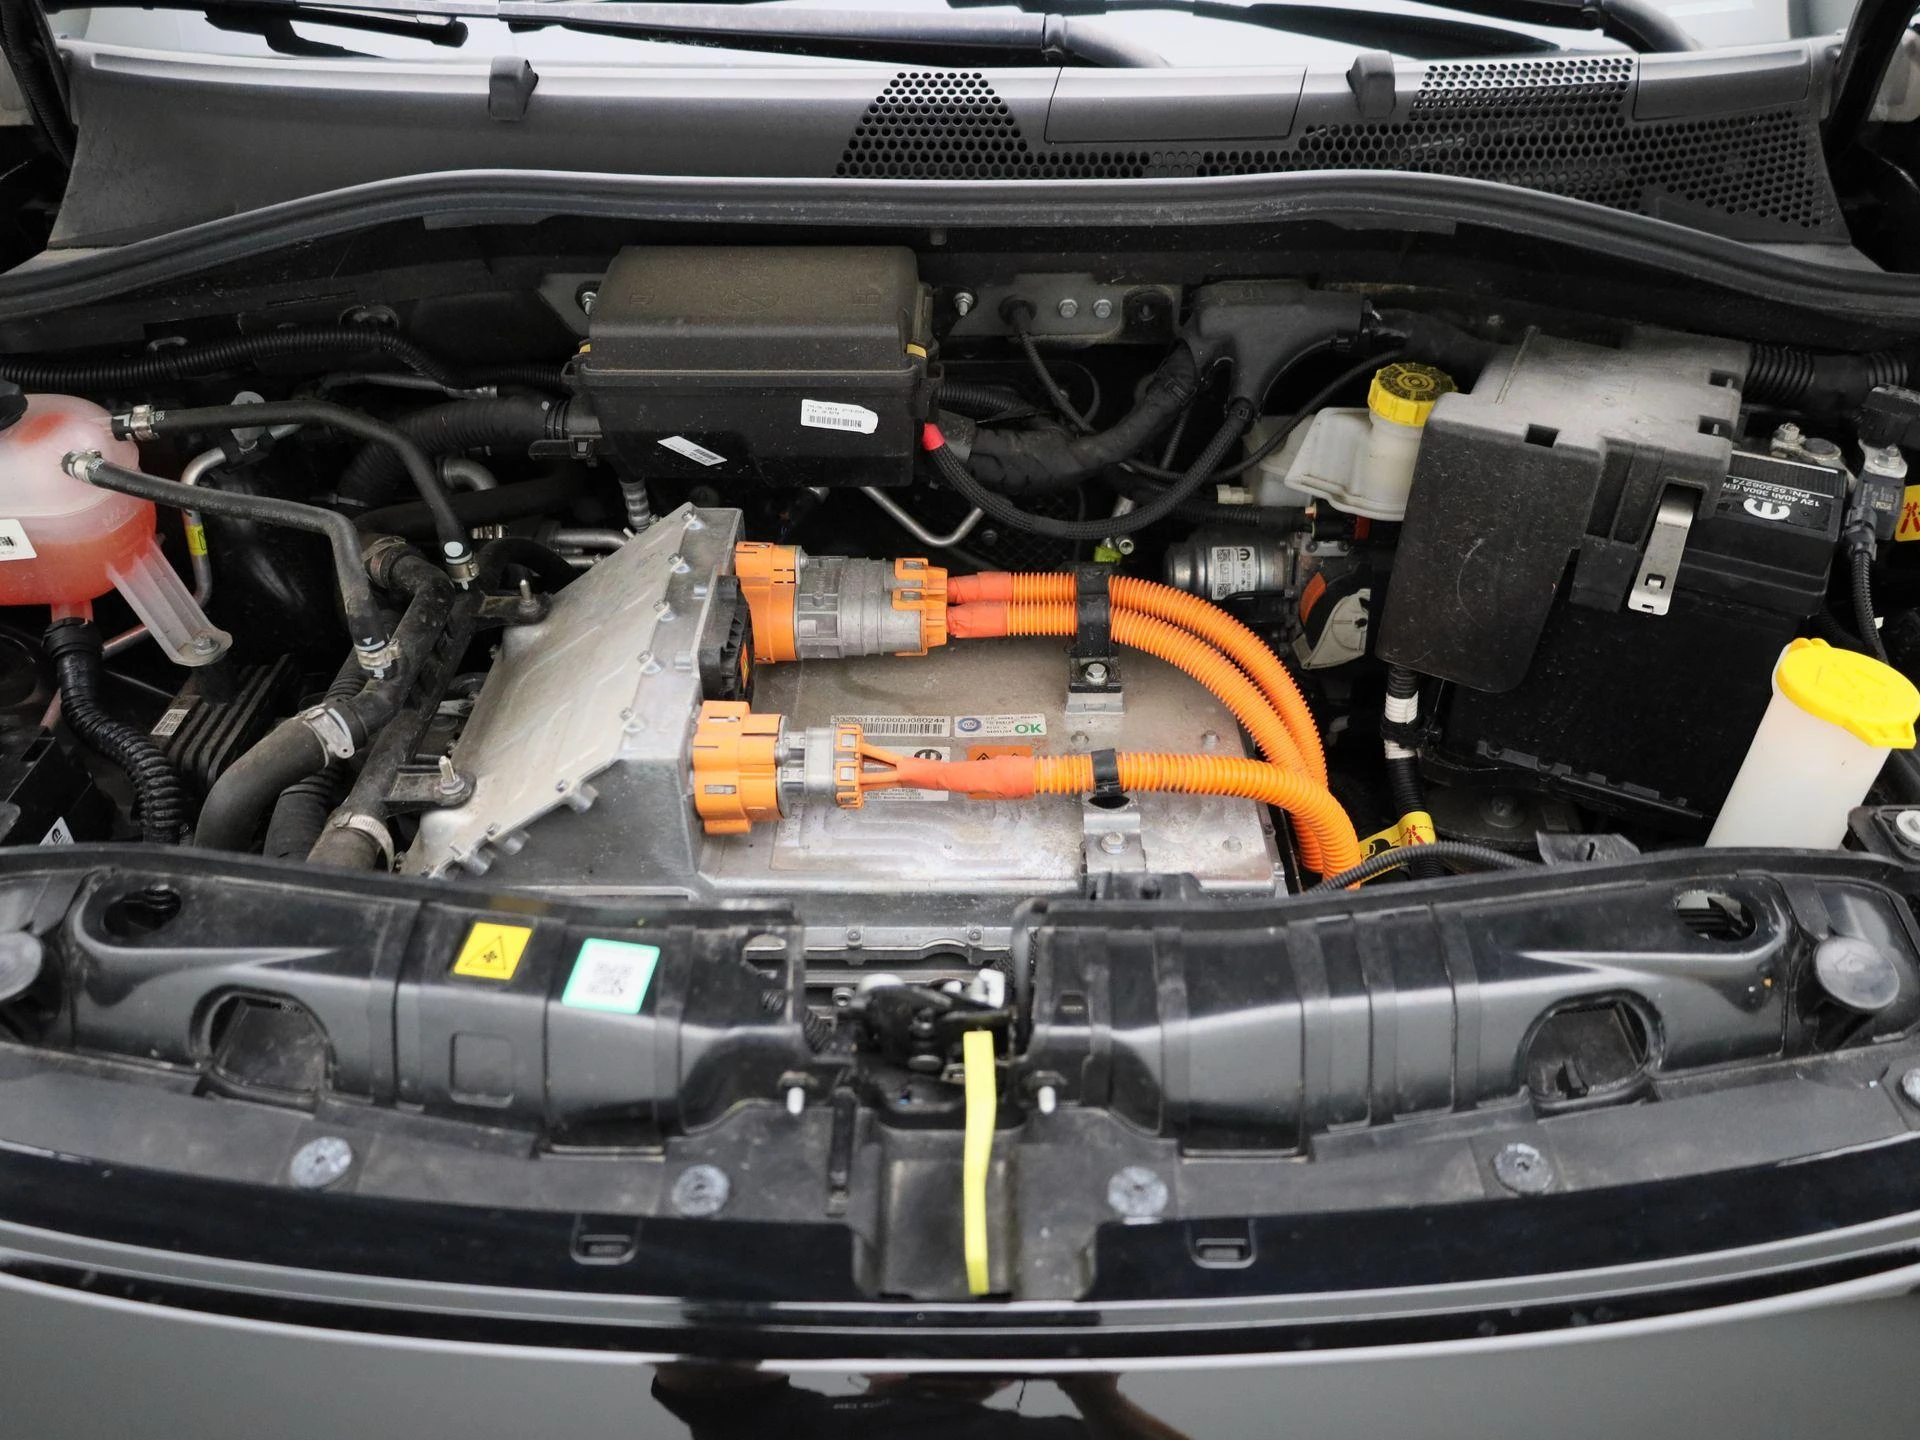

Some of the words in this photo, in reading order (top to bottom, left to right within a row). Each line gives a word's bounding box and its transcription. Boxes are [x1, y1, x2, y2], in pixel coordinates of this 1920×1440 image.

[1771, 492, 1798, 503] 40Ah
[1791, 489, 1810, 499] PN:
[1800, 498, 1820, 507] 12V
[1014, 723, 1042, 734] OK
